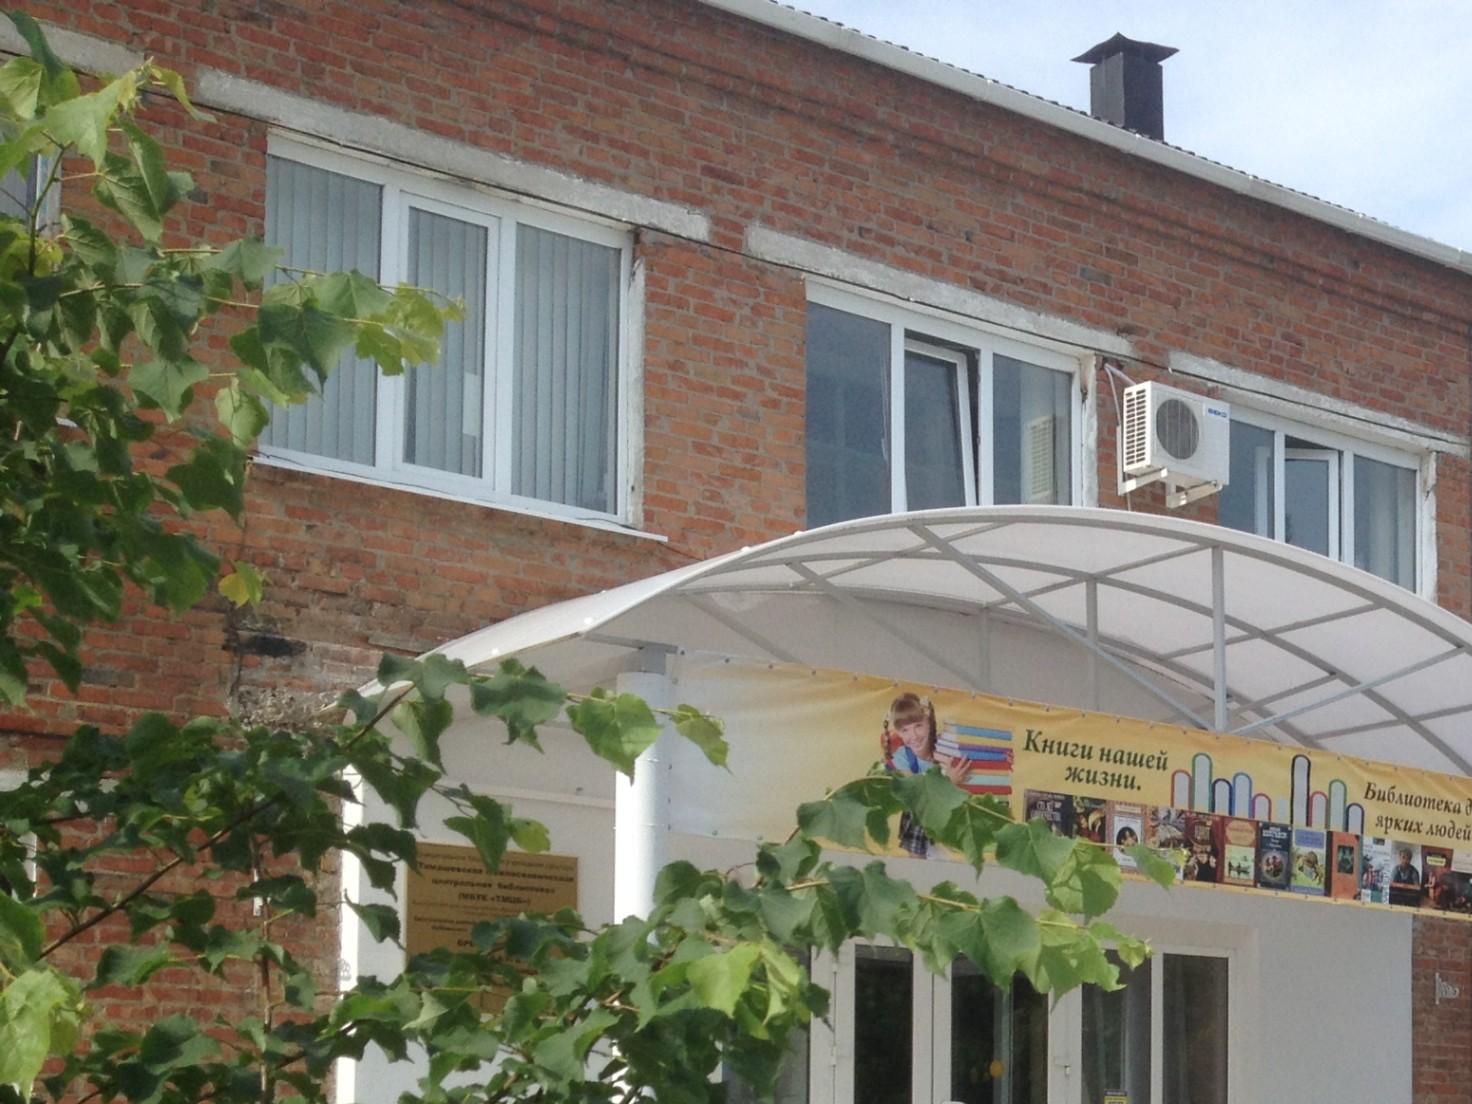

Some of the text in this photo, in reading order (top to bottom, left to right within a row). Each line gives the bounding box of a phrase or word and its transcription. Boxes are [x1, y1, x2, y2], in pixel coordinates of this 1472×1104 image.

[1023, 729, 1169, 771] Книги нашей
[1065, 766, 1142, 791] жизни.
[1363, 782, 1461, 815] Библиотека
[1375, 815, 1423, 834] ярких
